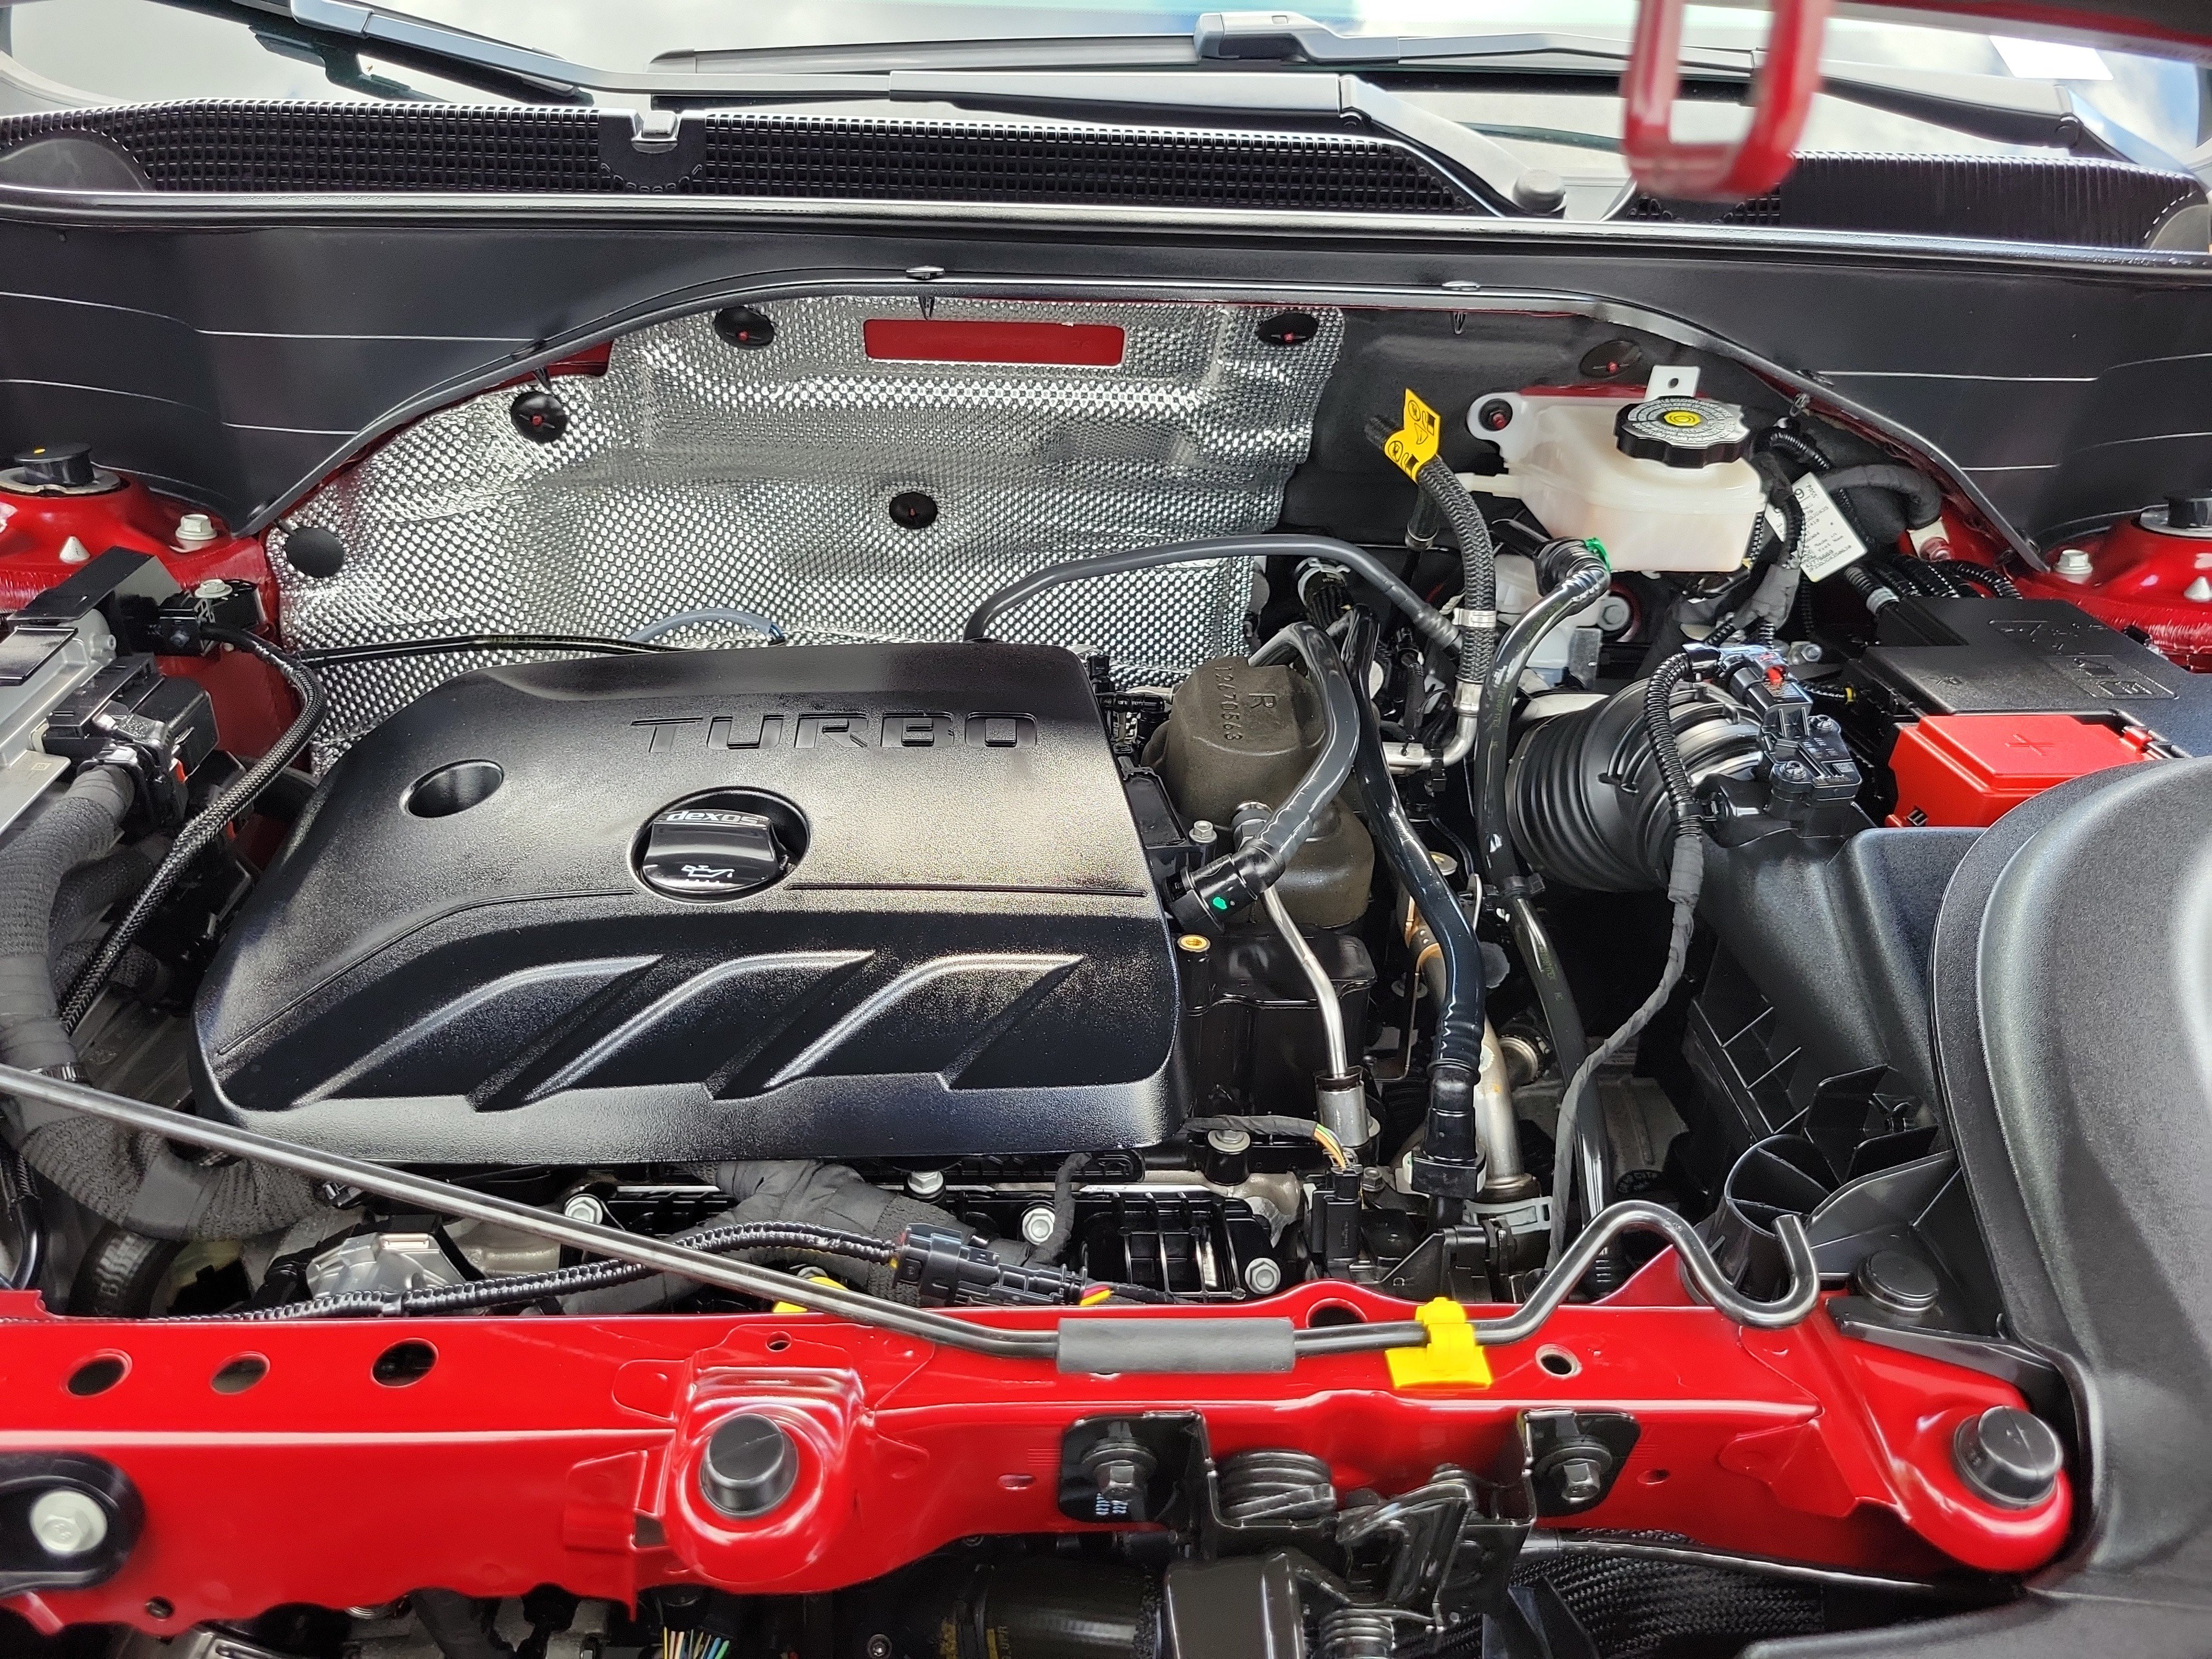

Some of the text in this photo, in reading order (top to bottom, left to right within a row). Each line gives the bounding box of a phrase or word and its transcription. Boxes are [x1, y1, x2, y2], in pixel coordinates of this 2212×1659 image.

[1248, 692, 1277, 708] R
[631, 712, 1037, 753] TURBO
[666, 811, 759, 824] dexos
